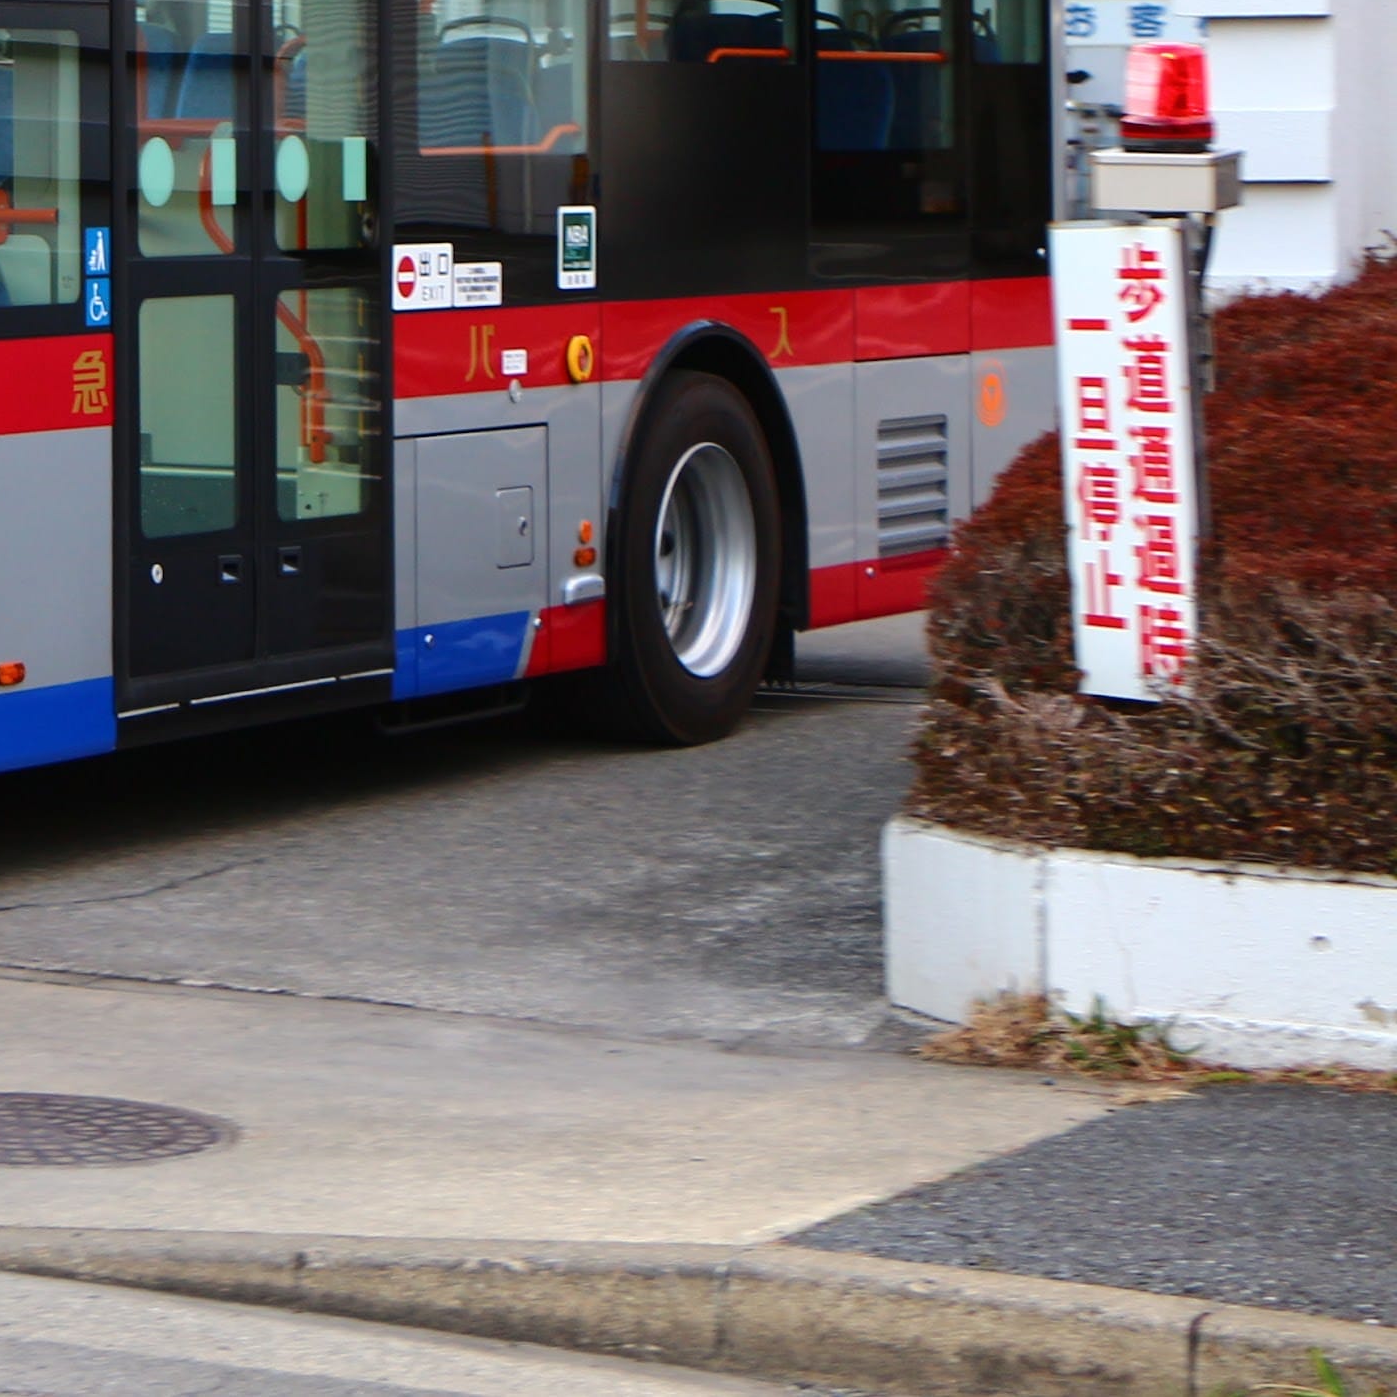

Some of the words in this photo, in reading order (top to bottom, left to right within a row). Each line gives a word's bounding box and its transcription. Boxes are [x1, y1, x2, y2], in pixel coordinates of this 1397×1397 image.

[419, 252, 449, 276] 出口
[422, 285, 445, 301] EXIT
[71, 350, 108, 415] 急
[1066, 318, 1129, 630] 一旦停止
